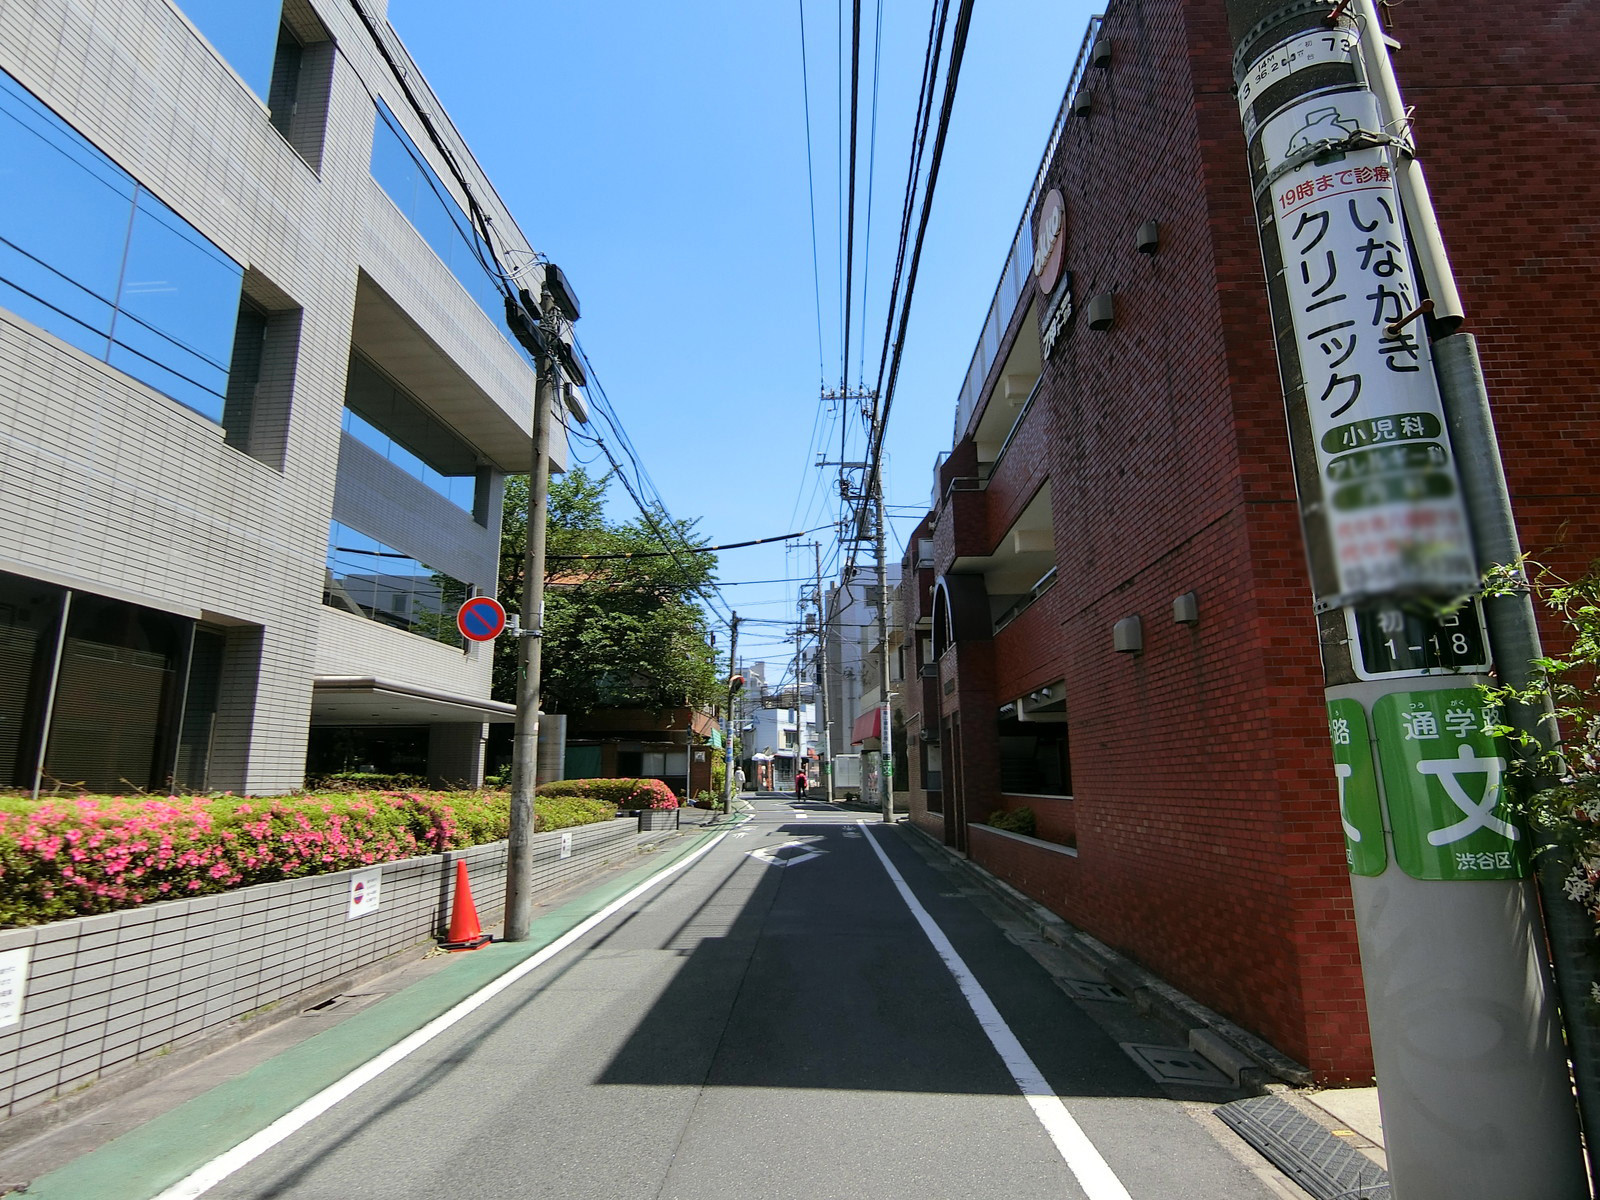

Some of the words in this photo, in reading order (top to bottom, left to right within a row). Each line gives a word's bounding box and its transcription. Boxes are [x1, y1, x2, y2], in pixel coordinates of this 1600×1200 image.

[1257, 54, 1276, 72] 14M
[1278, 165, 1391, 209] 19時まで診療
[1348, 196, 1419, 372] いながき
[1291, 211, 1362, 419] クリニック
[1342, 415, 1425, 447] 小児科
[1384, 632, 1468, 660] 1-18
[1416, 743, 1521, 847] 文
[1455, 851, 1512, 871] 渋谷区
